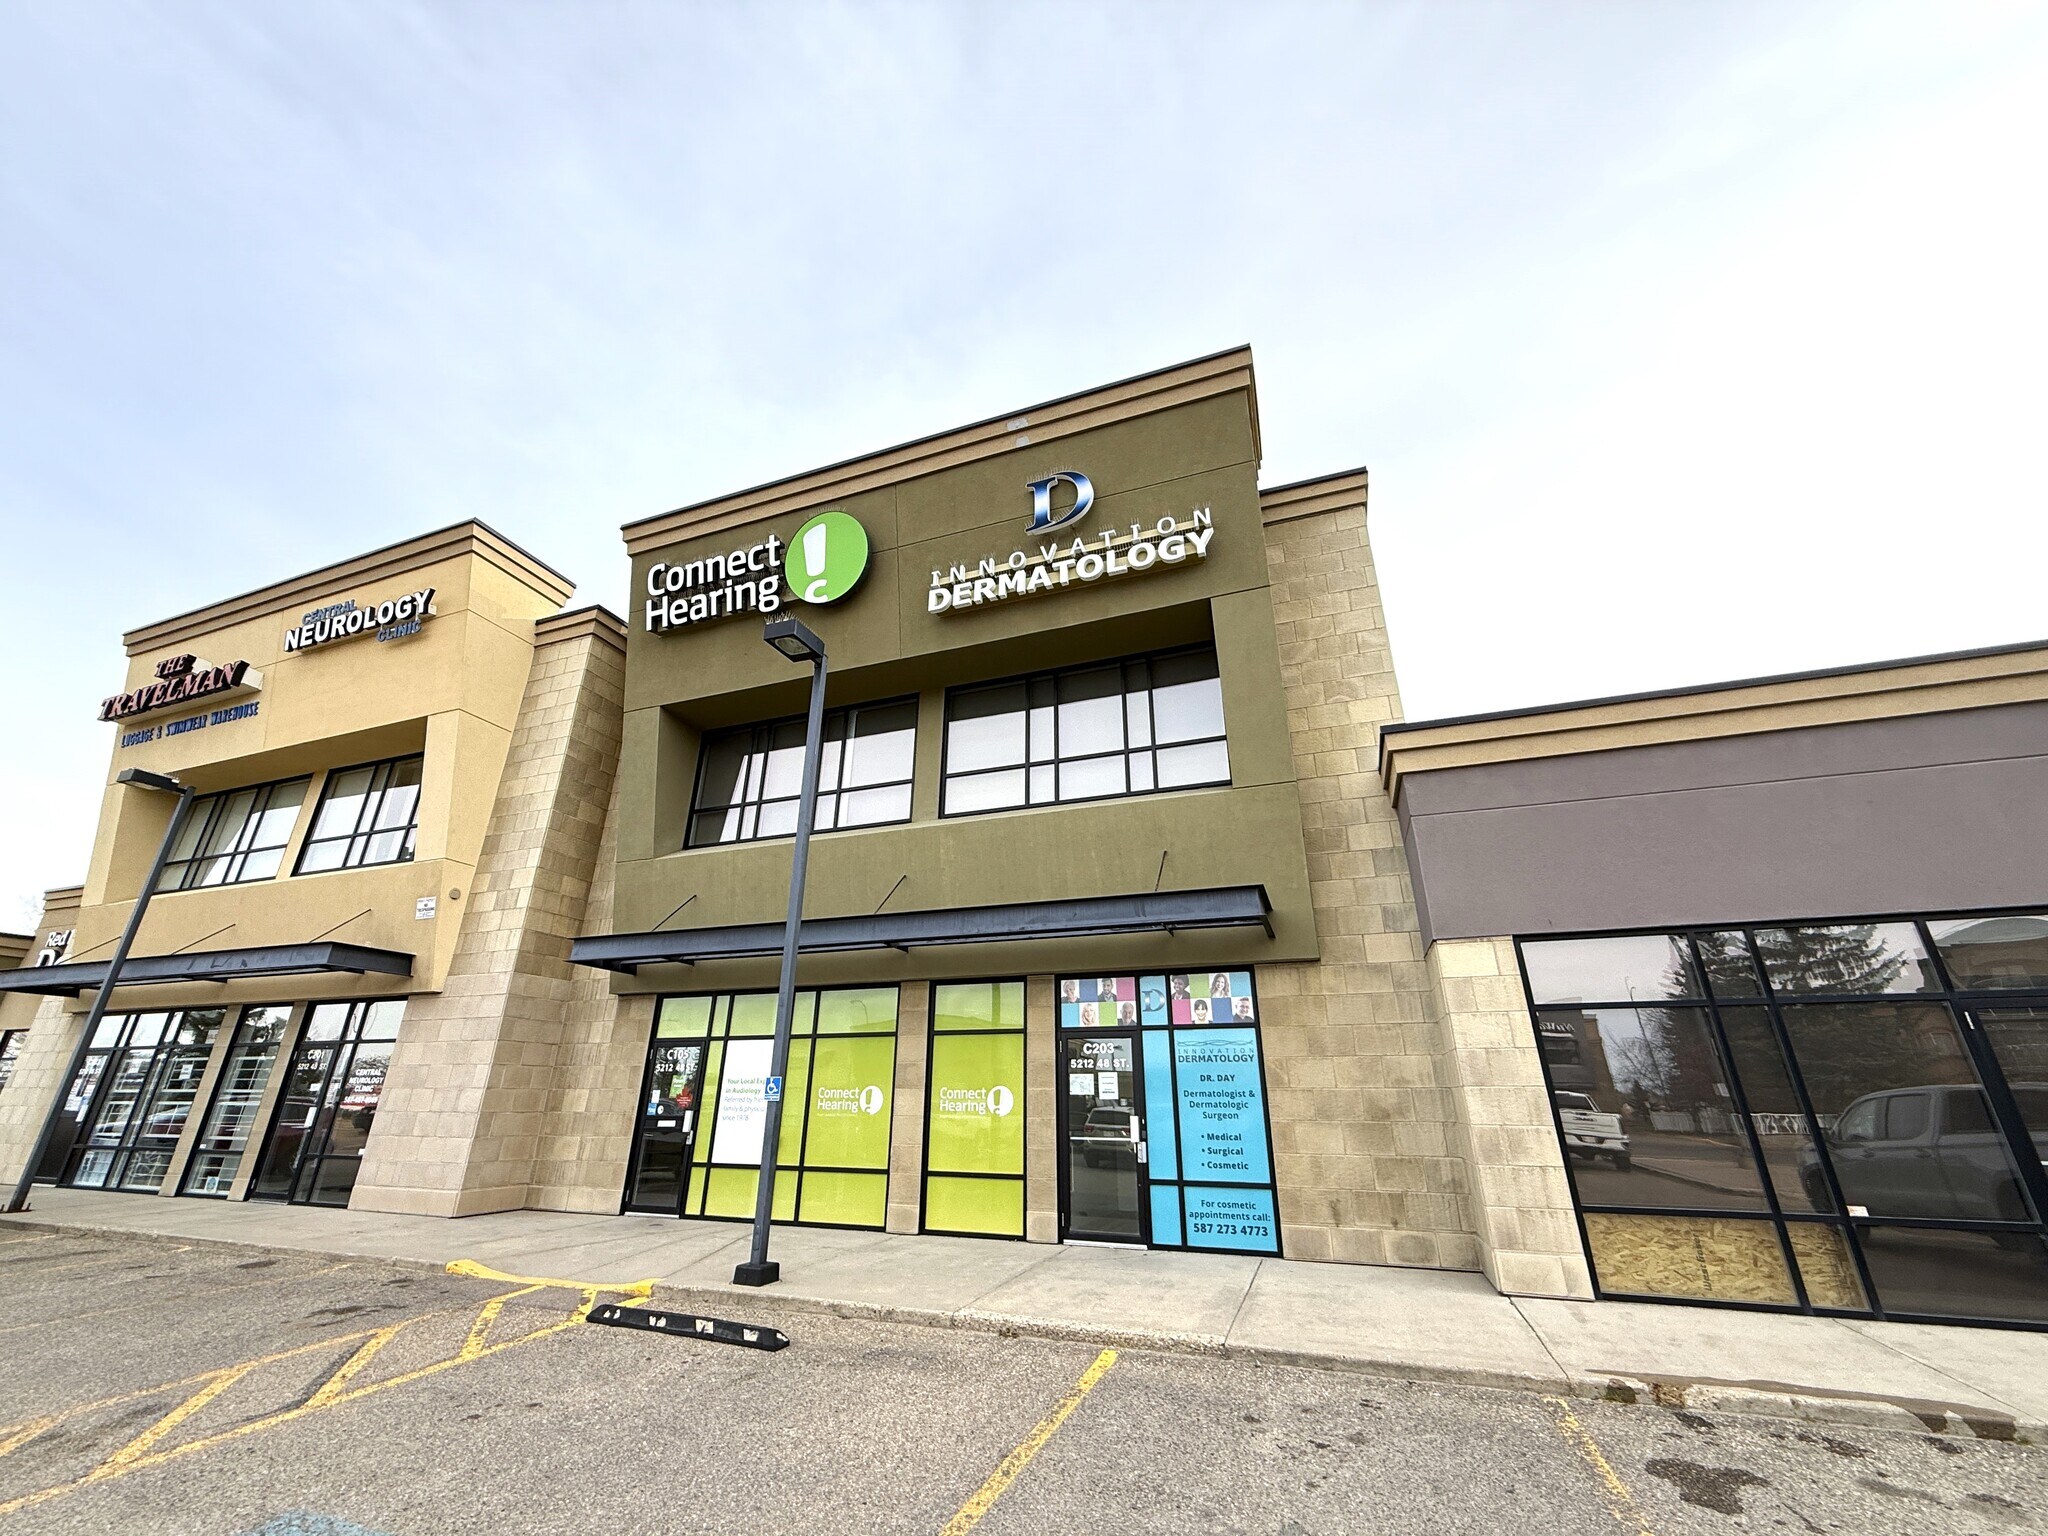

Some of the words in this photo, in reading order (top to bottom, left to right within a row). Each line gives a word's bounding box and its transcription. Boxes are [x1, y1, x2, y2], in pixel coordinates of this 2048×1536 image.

[1025, 470, 1095, 536] D
[930, 507, 1212, 589] INNOVATION
[647, 534, 781, 597] Connect
[927, 527, 1215, 614] DERMATOLOGY
[645, 574, 780, 632] Hearing
[302, 599, 358, 625] CENTRAL
[284, 588, 435, 651] NEUROLOGY
[376, 619, 422, 643] CLINIC
[155, 654, 192, 677] THE
[97, 660, 246, 721] TRAVELMAN
[121, 728, 154, 748] LUGGAGE
[165, 714, 208, 737] SWIMWEAR
[210, 701, 260, 726] WAREHOUSE
[45, 929, 70, 948] Red
[1083, 1042, 1115, 1054] C203
[1178, 1047, 1254, 1055] INNOVATION
[667, 1049, 689, 1060] C105
[1178, 1054, 1254, 1063] DERMATOLOGY
[656, 1063, 674, 1072] 5212
[675, 1063, 685, 1072] 48
[1070, 1058, 1094, 1068] 5212
[1096, 1058, 1110, 1068] 48
[1113, 1058, 1130, 1068] ST.
[1200, 1074, 1215, 1082] DR.
[1217, 1074, 1236, 1082] DAY
[732, 1087, 761, 1095] Audiology
[818, 1087, 860, 1099] Connect
[940, 1087, 987, 1099] Connect
[1183, 1089, 1246, 1100] Dermatologist
[1248, 1089, 1256, 1098] &
[817, 1099, 859, 1113] Hearing
[940, 1099, 987, 1115] Hearing
[1189, 1100, 1249, 1111] Dermatologic
[1202, 1111, 1239, 1121] Surgeon
[1206, 1132, 1242, 1141] Medical
[1207, 1146, 1244, 1157] Surgical
[1207, 1161, 1249, 1170] Cosmetic
[1201, 1199, 1215, 1208] For
[1217, 1201, 1257, 1210] cosmetic
[1189, 1211, 1250, 1221] appointments
[1252, 1213, 1271, 1222] call:
[1193, 1222, 1213, 1234] 587
[1216, 1223, 1237, 1235] 273
[1240, 1225, 1269, 1237] 4773
